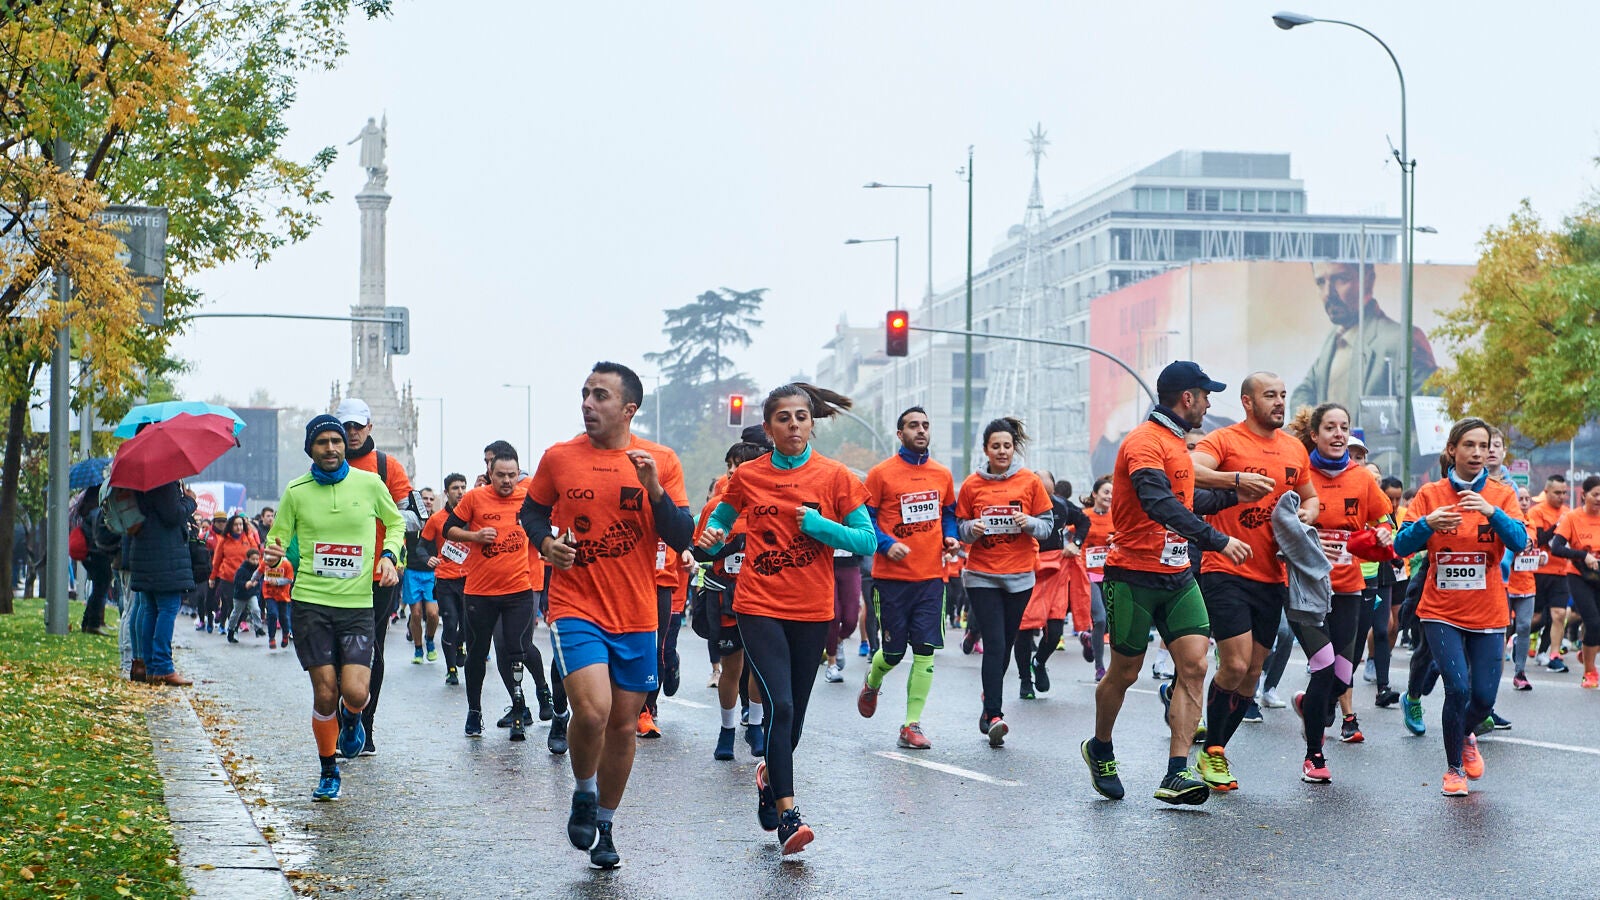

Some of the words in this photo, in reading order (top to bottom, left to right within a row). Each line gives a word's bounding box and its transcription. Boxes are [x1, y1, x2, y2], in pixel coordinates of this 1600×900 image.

[908, 503, 934, 513] 13990
[989, 518, 1013, 526] 13141
[322, 557, 354, 568] 15784
[1445, 567, 1476, 578] 9500
